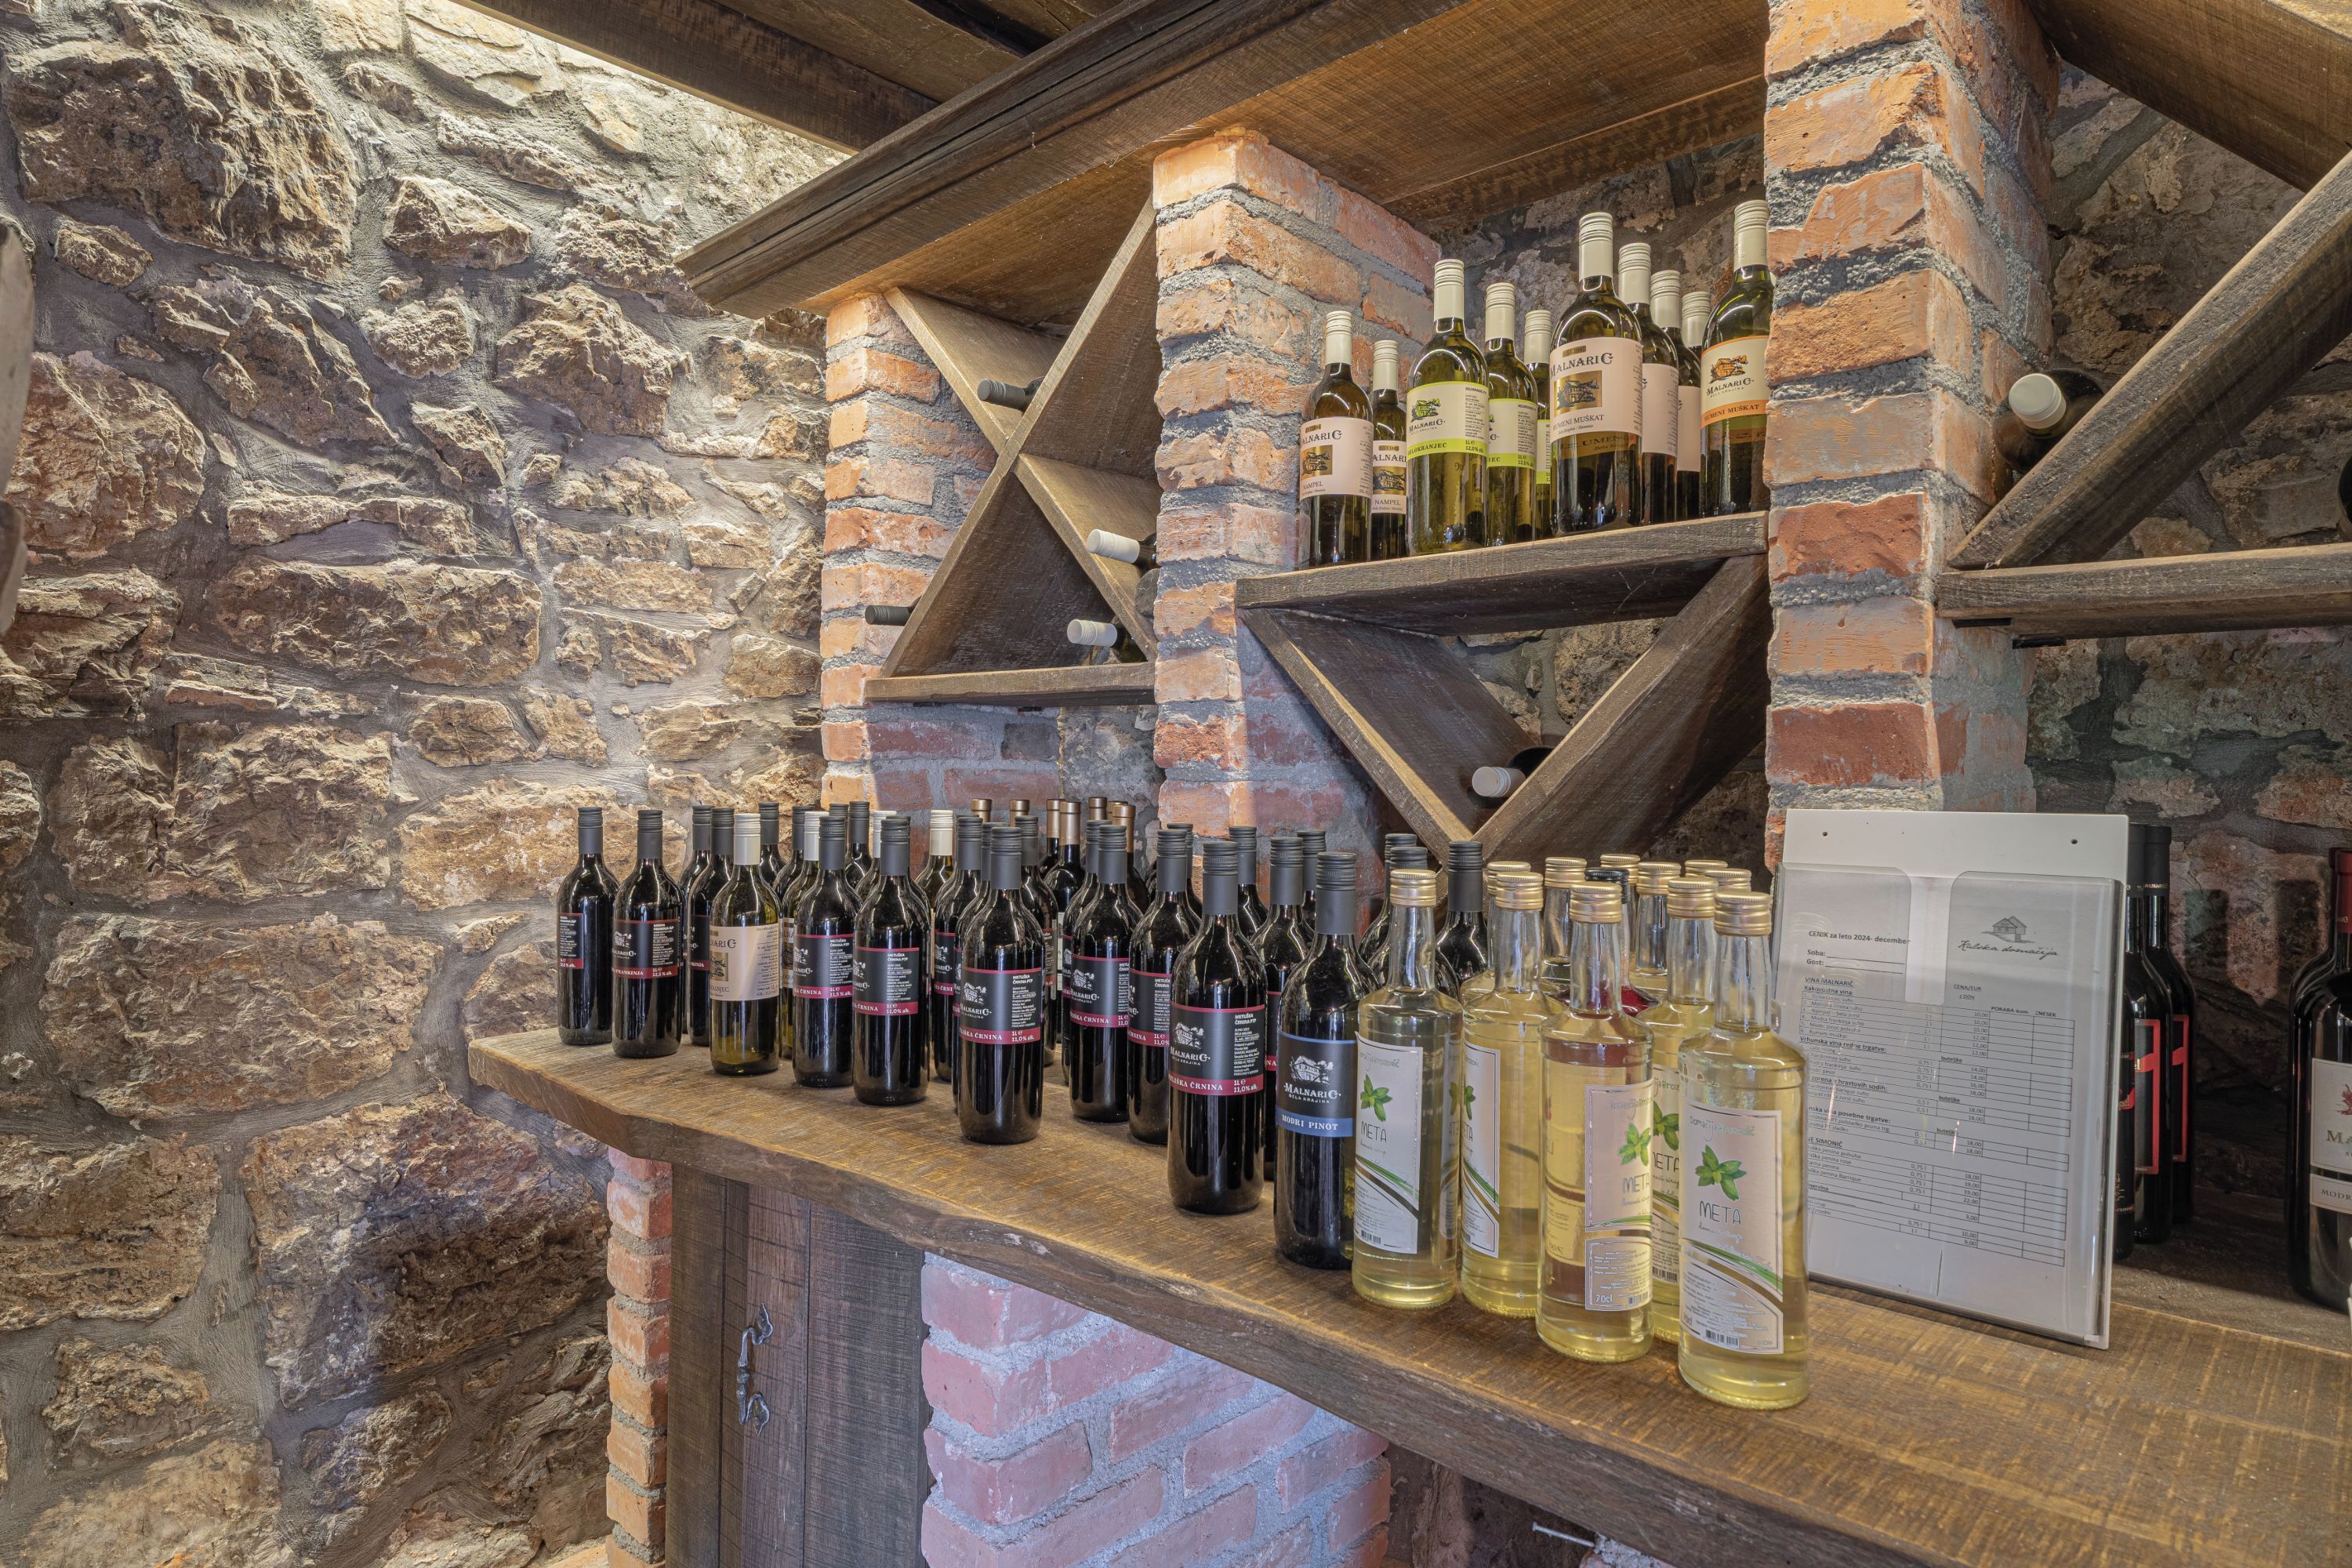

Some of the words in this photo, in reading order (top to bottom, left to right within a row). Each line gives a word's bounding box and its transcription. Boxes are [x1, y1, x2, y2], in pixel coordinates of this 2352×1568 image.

[1727, 404, 1760, 413] MUŠKAT
[1573, 414, 1604, 423] MUŠKAT
[1373, 454, 1406, 463] ALNARI
[1875, 936, 1911, 945] december
[2002, 946, 2059, 960] domačija
[1820, 978, 1853, 987] MALNARIČ
[960, 1028, 973, 1037] TLIŠKA
[1800, 1036, 1828, 1045] Vrhunska
[1862, 1044, 1887, 1054] trgatve:
[1808, 1052, 1838, 1062] hardonnay
[1168, 1073, 1188, 1087] ETLIŠKA
[1190, 1081, 1223, 1091] ČRNINA
[1838, 1080, 1867, 1088] hrastovih
[1303, 1095, 1330, 1104] KRAJINA
[1282, 1114, 1305, 1127] MODRI
[1308, 1121, 1338, 1131] PINOT
[1838, 1111, 1864, 1120] posebne
[1865, 1115, 1891, 1124] trgatve:
[1361, 1121, 1387, 1143] META
[2321, 1189, 2352, 1201] MODR
[1700, 1200, 1741, 1226] META
